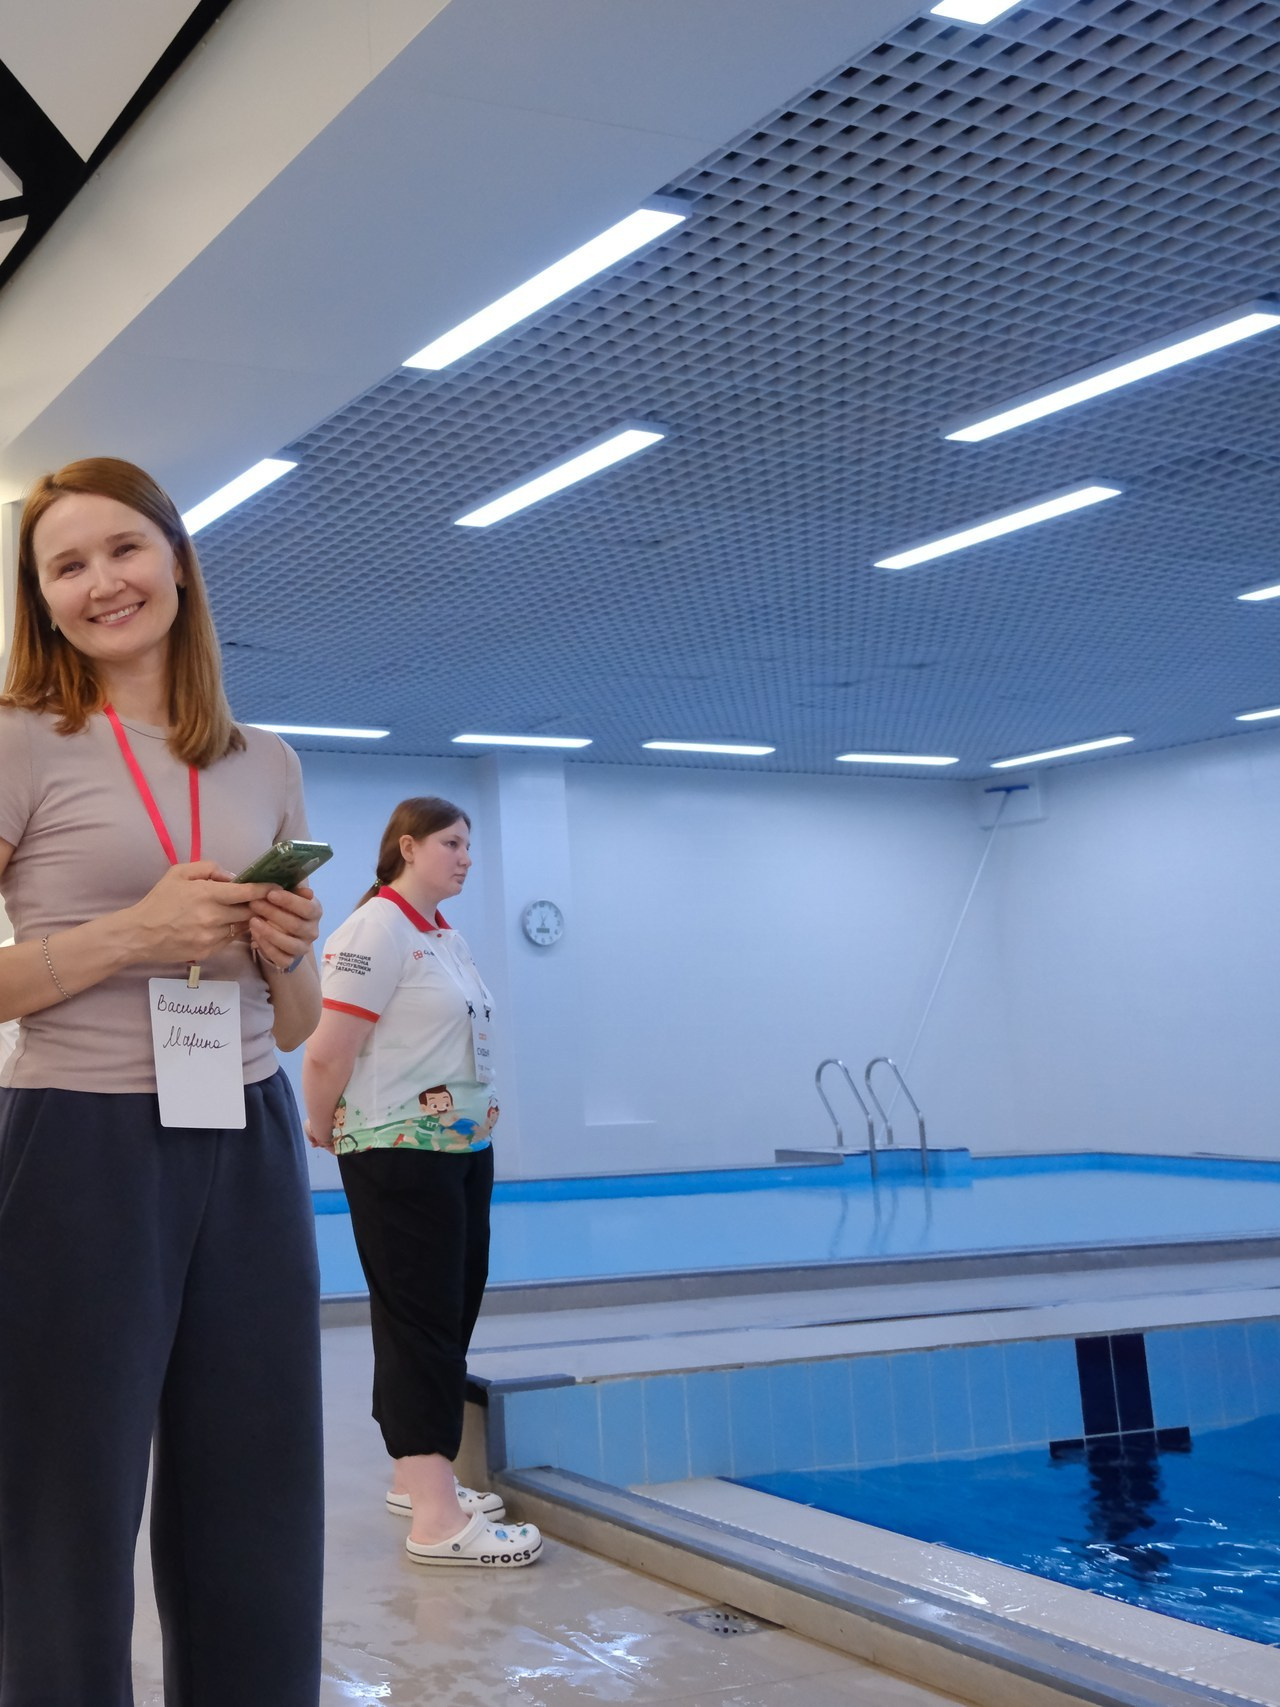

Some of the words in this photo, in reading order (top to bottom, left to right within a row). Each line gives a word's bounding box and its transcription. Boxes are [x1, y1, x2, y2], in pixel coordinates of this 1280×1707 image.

[335, 965, 366, 976] ТАТАРСТАН
[157, 994, 231, 1016] Васильева
[163, 1025, 230, 1056] Марина
[480, 1549, 531, 1564] crocs
